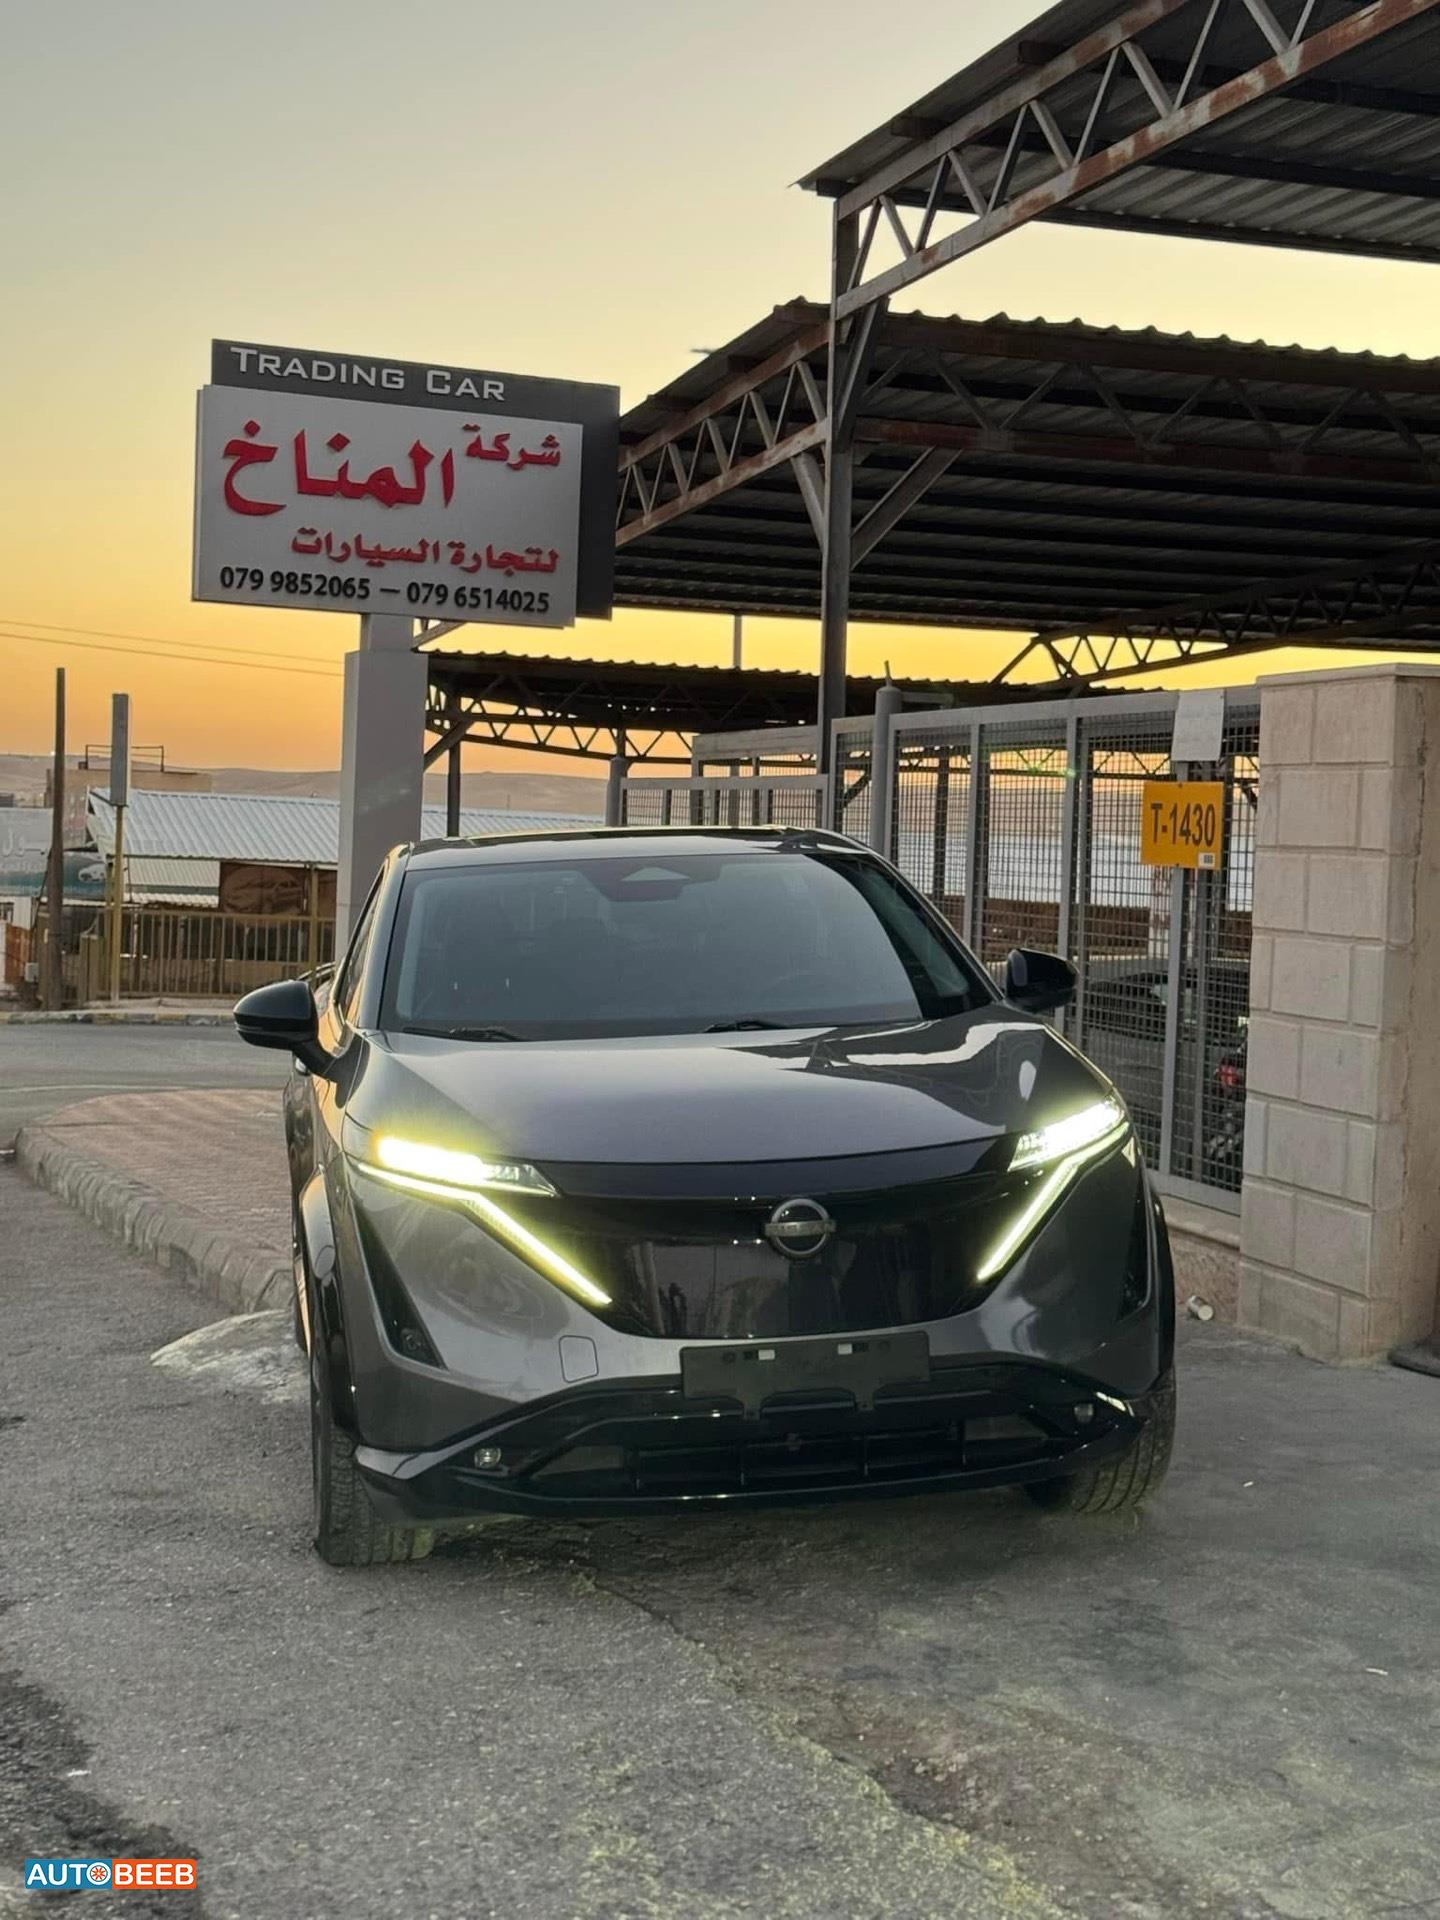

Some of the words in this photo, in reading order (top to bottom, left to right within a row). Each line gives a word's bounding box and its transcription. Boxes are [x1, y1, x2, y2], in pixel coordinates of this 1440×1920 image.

[230, 346, 406, 390] TRADING
[426, 370, 506, 402] CAR
[221, 419, 456, 517] المناخ
[462, 423, 562, 471] شركة
[290, 526, 441, 568] السيارات
[447, 540, 560, 578] لتجارة
[219, 566, 265, 591] 079
[270, 570, 371, 600] 9852065
[406, 582, 449, 606] 079
[453, 585, 550, 613] 6514025
[1150, 802, 1216, 848] T-1430
